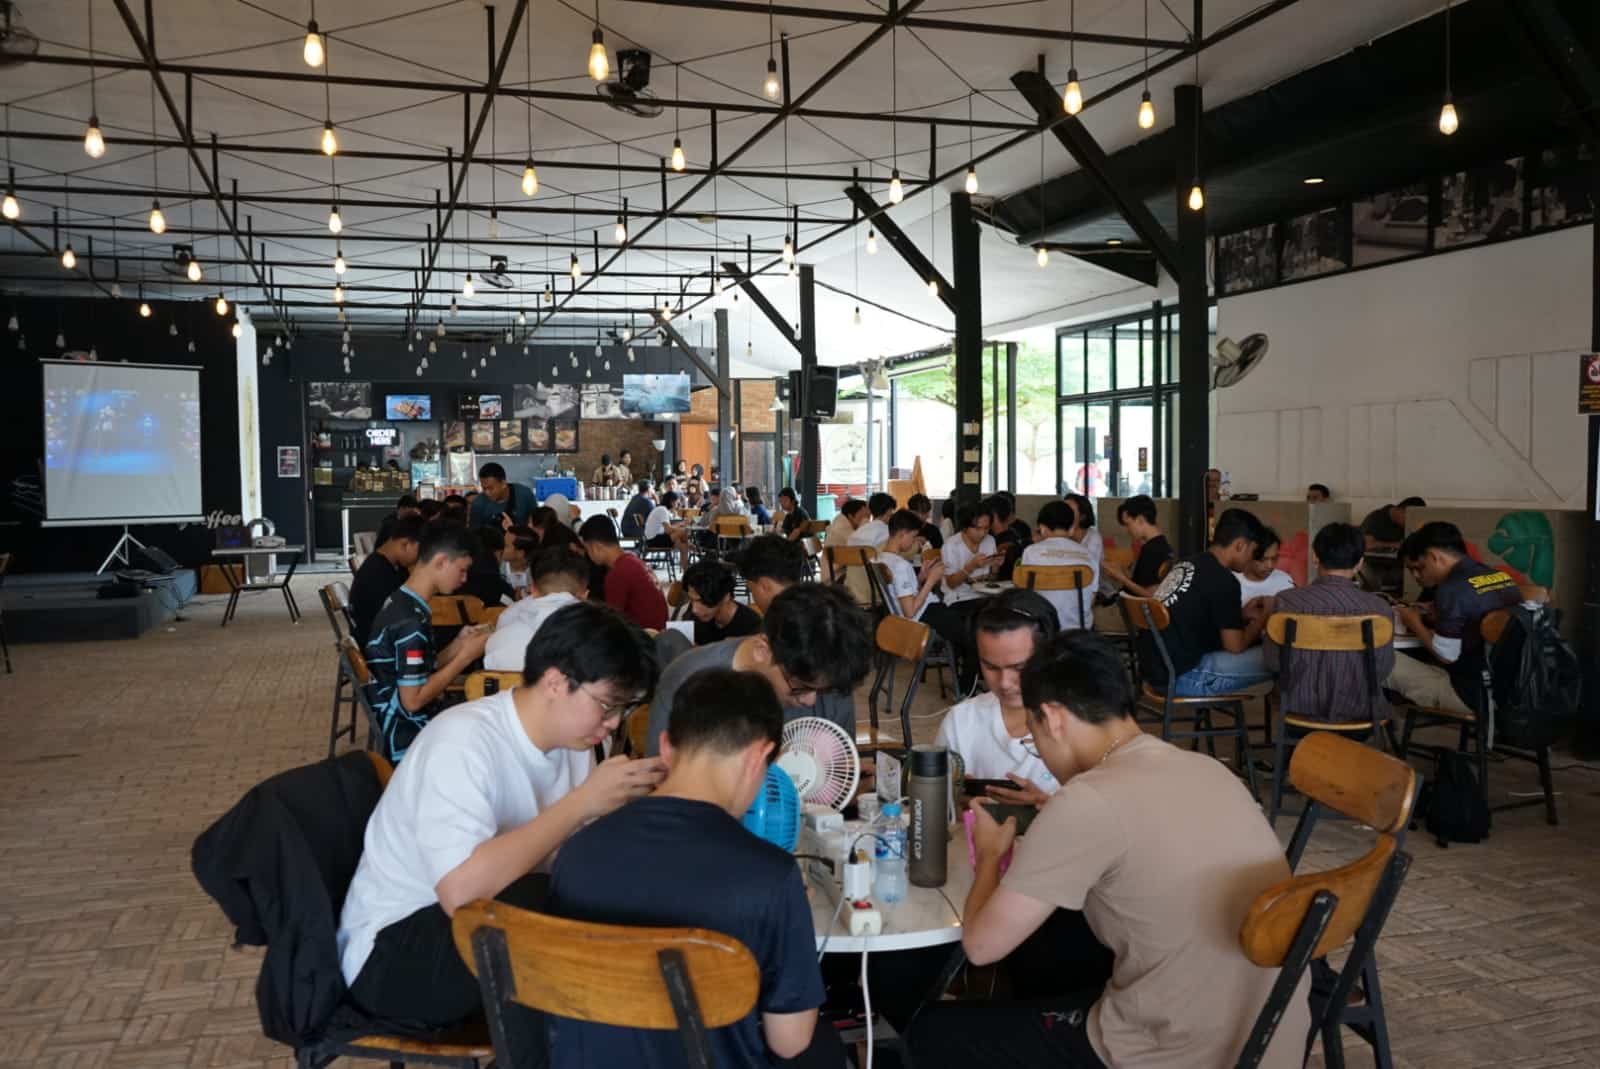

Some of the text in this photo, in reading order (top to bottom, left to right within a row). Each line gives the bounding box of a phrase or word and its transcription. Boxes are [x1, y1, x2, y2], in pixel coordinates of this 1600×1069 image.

[366, 428, 396, 437] ORDER
[370, 437, 392, 446] HERE
[913, 799, 922, 860] PORTABLE CUP
